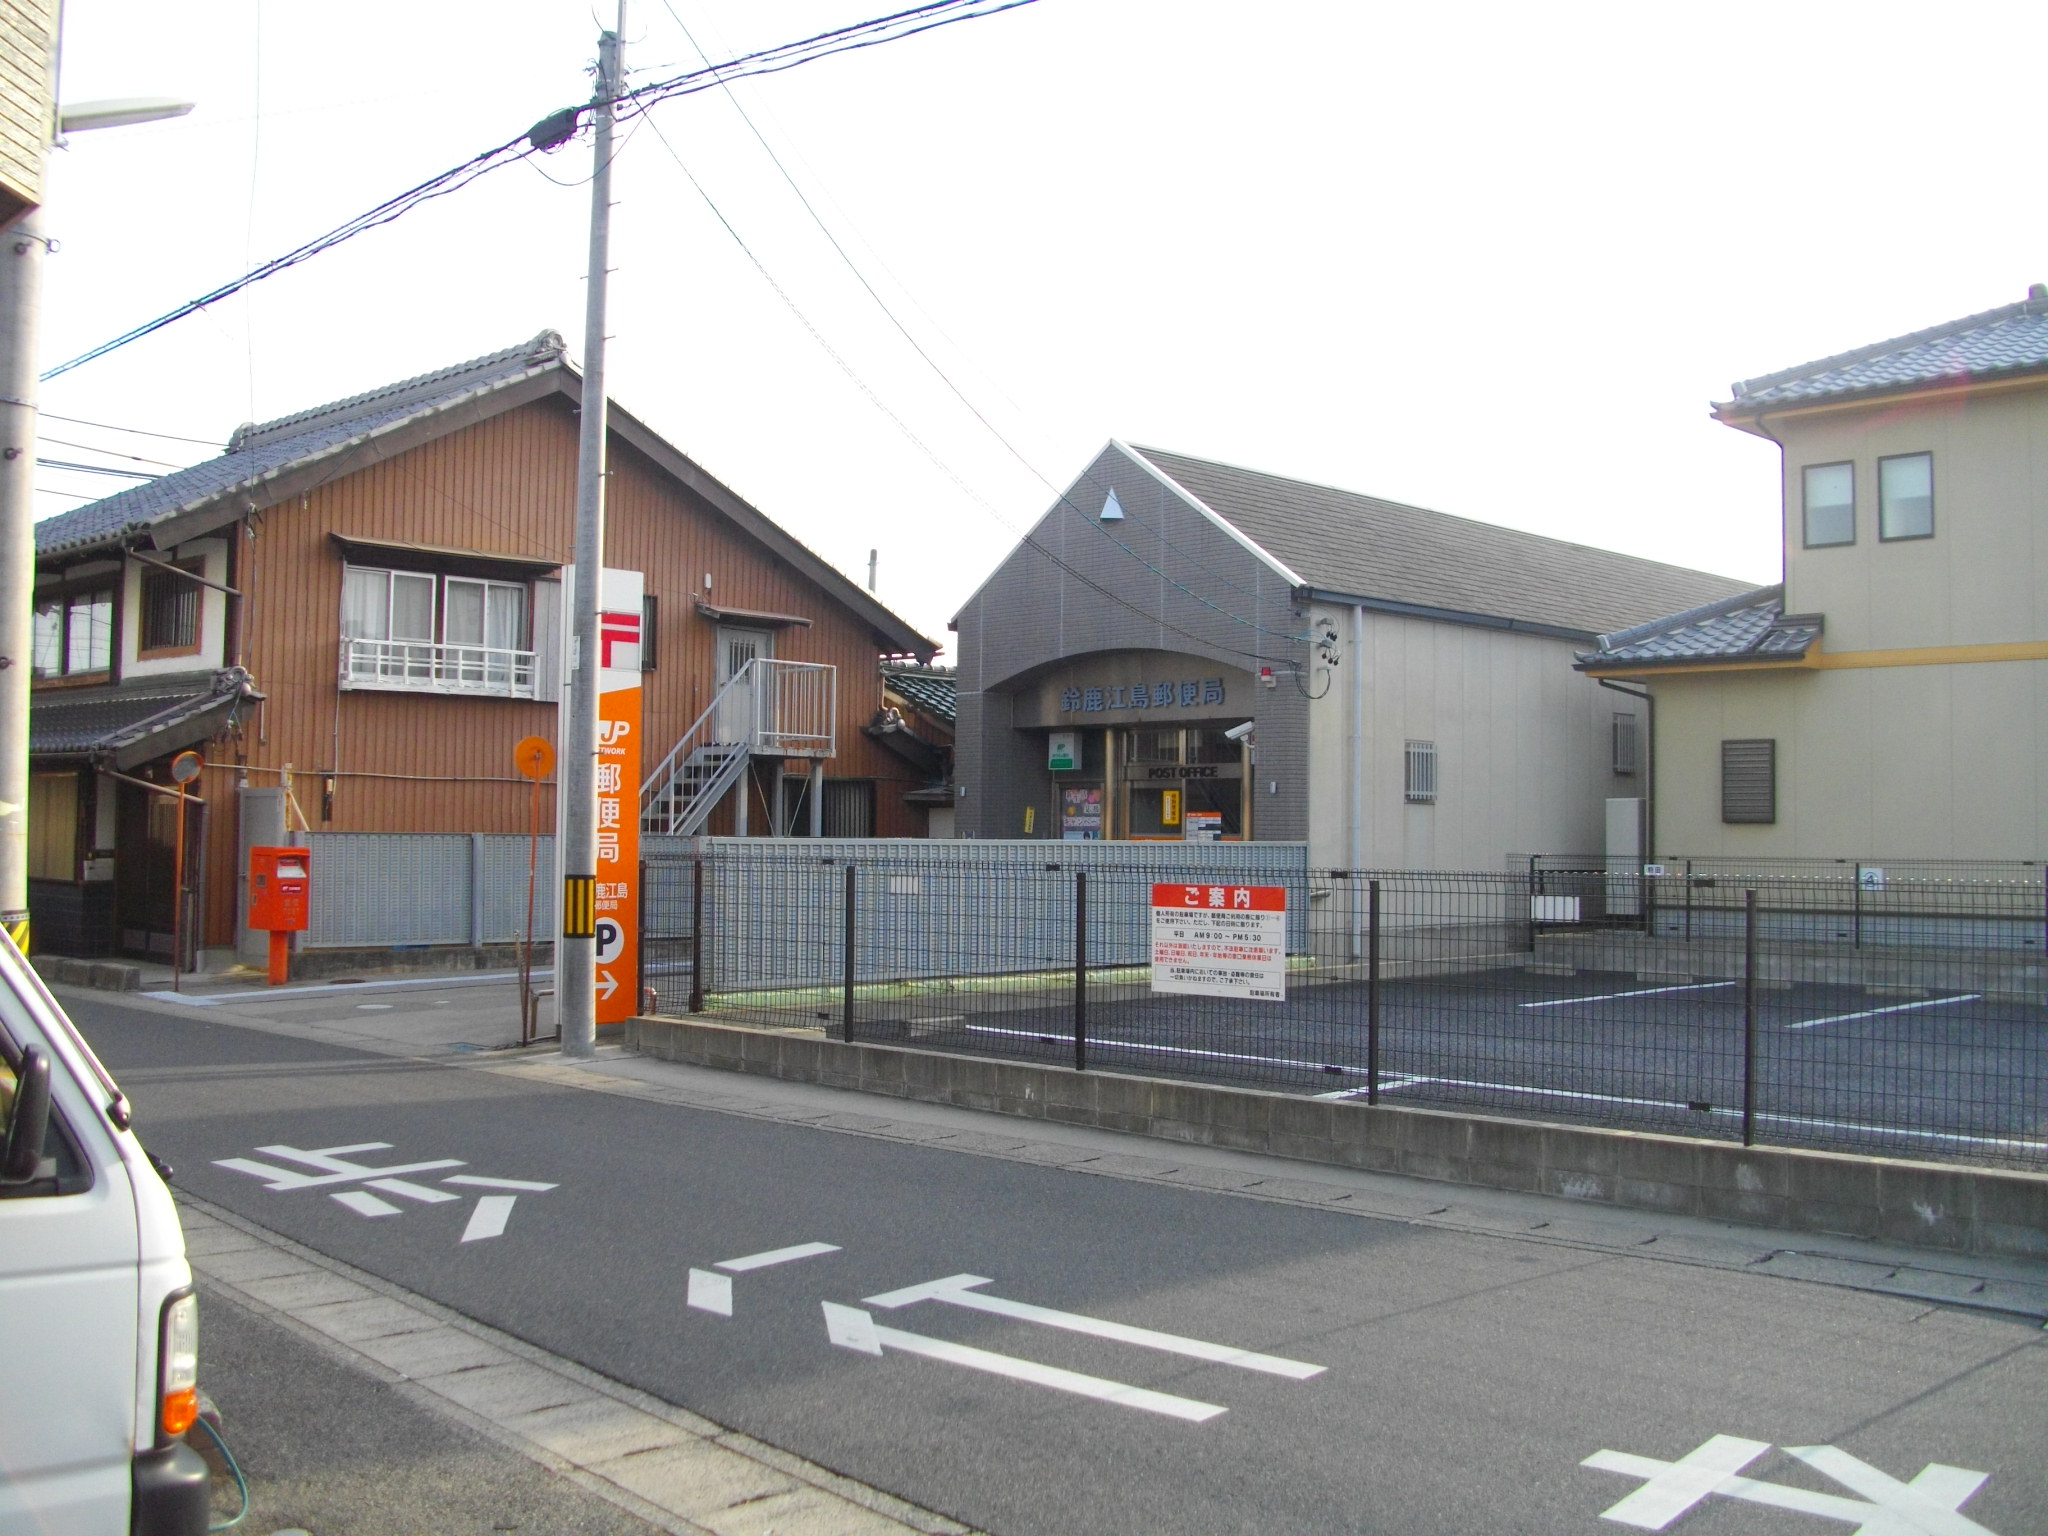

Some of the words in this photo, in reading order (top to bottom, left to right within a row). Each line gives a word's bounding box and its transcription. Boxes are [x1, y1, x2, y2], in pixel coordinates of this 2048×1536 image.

[1060, 677, 1226, 713] 鈴鹿江島郵便局
[599, 720, 631, 745] JP
[1148, 767, 1176, 778] POST
[1179, 766, 1218, 778] OFFICE
[596, 763, 621, 863] 郵便局
[596, 882, 628, 898] 鹿江島
[1185, 887, 1250, 908] ご案内
[596, 924, 616, 956] P
